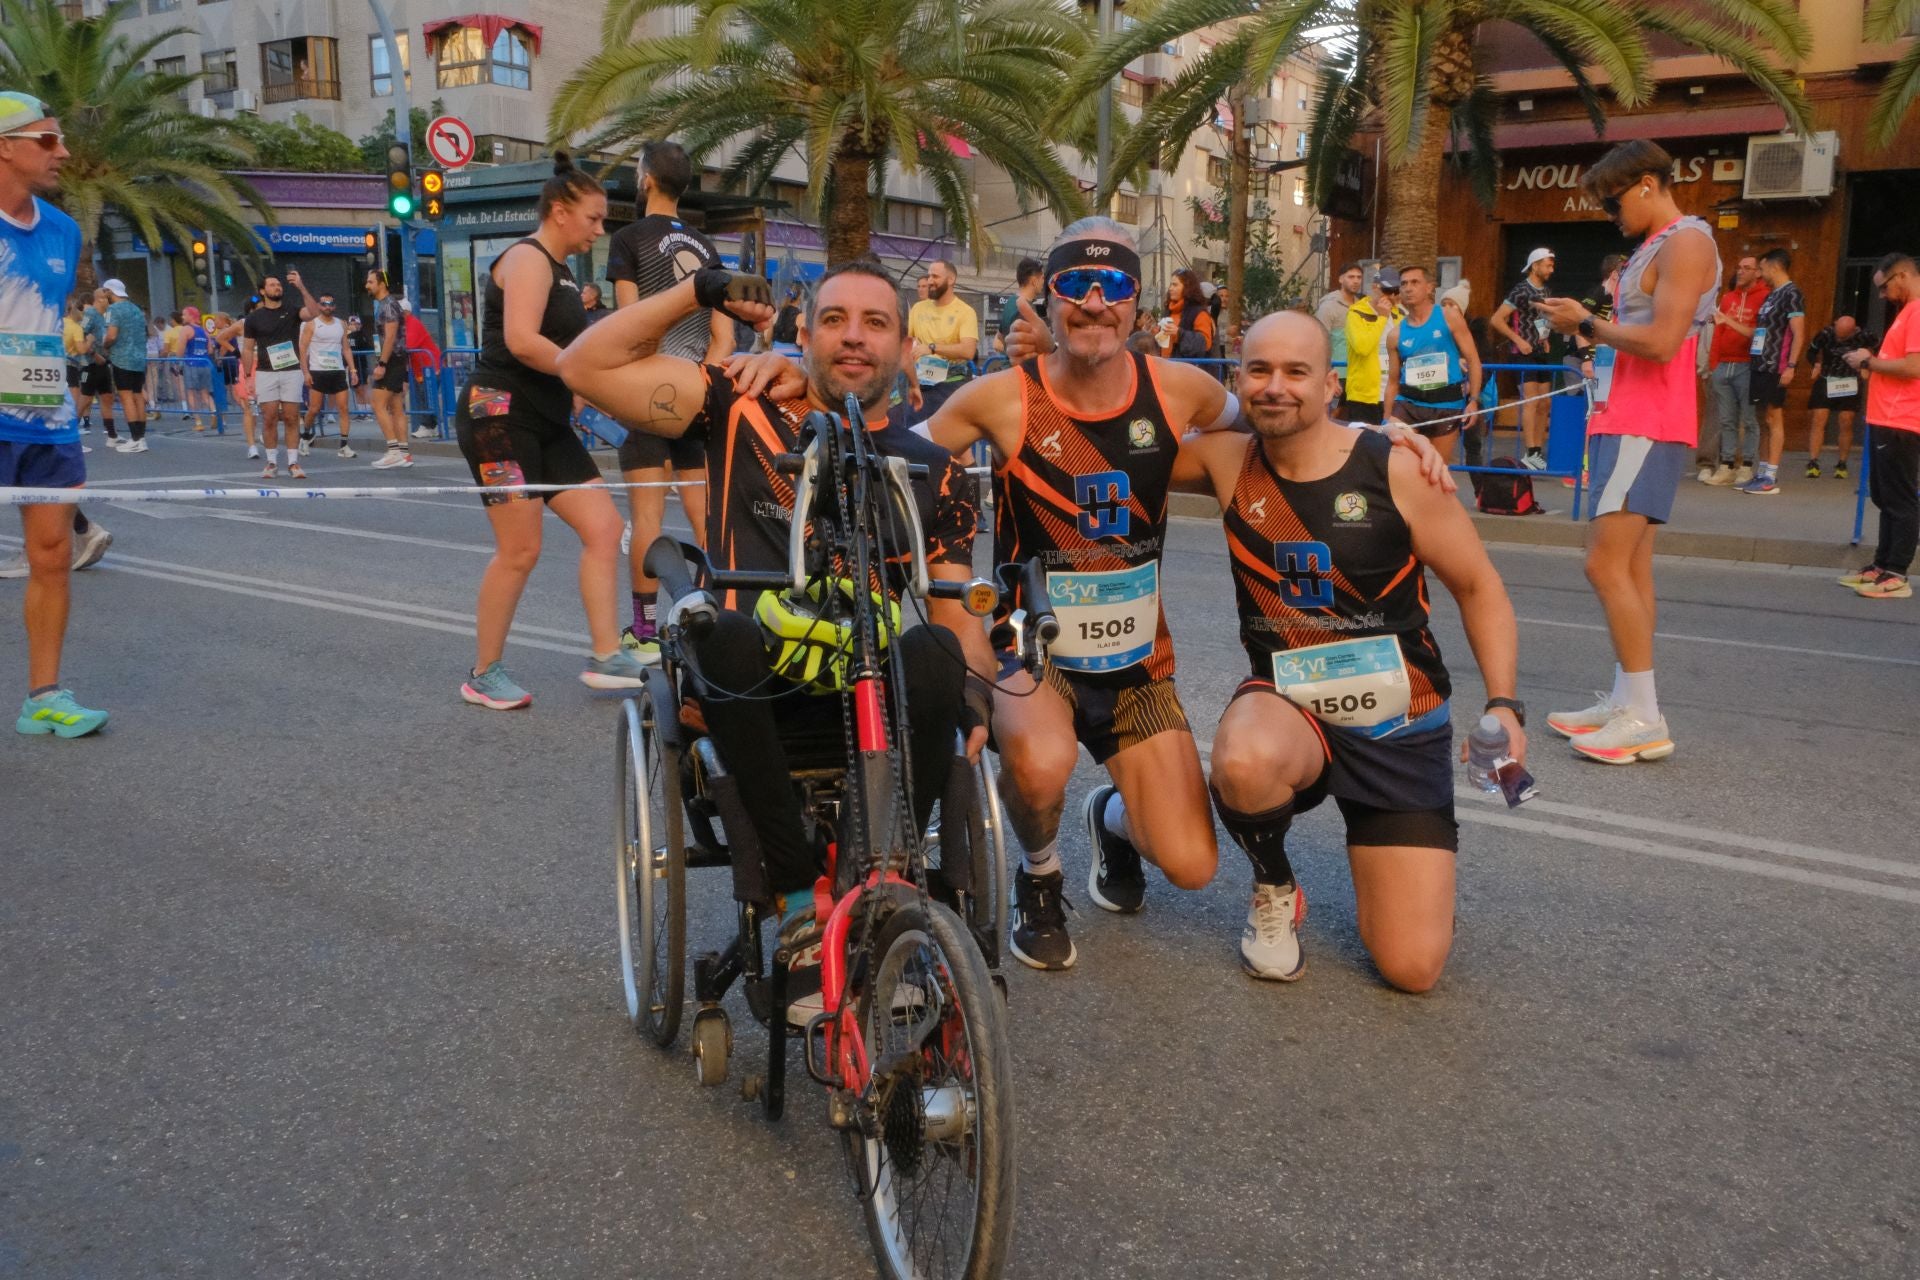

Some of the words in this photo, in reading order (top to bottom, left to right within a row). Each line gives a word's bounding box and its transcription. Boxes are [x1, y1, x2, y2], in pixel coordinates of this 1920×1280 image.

[1507, 164, 1580, 191] NOU
[456, 212, 479, 226] Avda.
[480, 211, 491, 224] De
[22, 367, 61, 382] 2539
[1416, 370, 1436, 379] 1567
[753, 500, 794, 522] MHR
[1078, 616, 1136, 640] 1508
[1310, 692, 1377, 714] 1506
